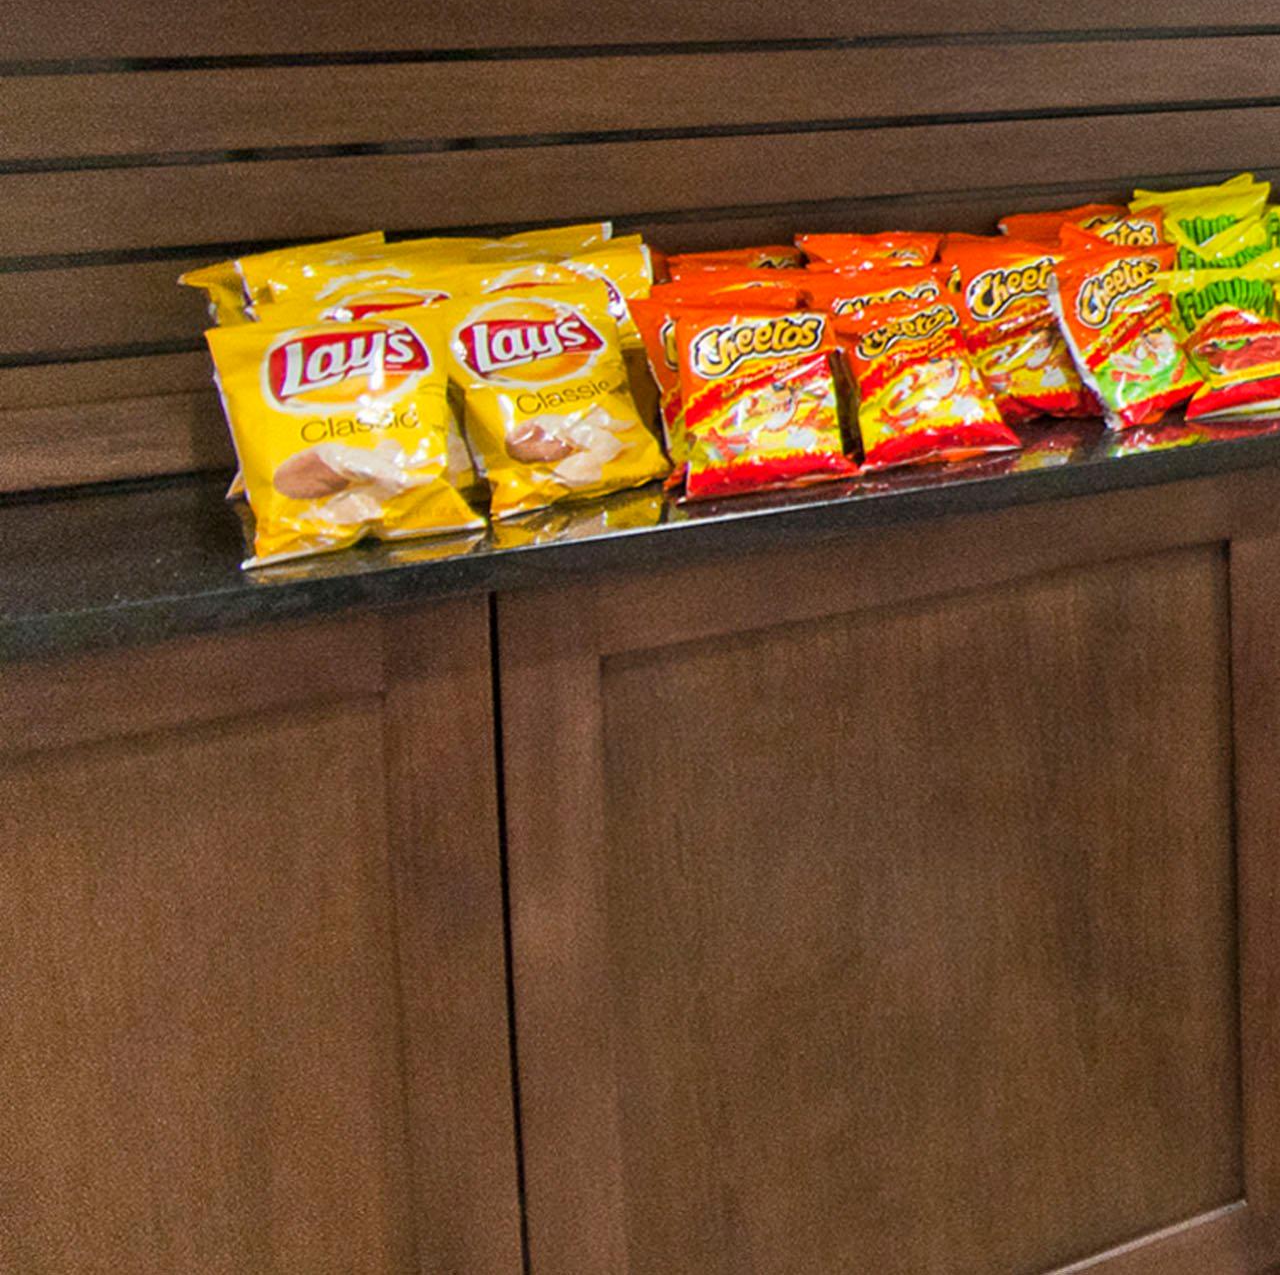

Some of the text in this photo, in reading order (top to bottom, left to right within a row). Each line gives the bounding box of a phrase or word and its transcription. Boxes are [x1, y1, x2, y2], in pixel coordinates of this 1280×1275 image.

[967, 257, 1055, 321] Cheet
[278, 324, 421, 398] Lay's
[474, 314, 590, 375] Lay's
[694, 316, 823, 377] Cheetos
[300, 409, 419, 445] Classic
[515, 379, 612, 416] Classic
